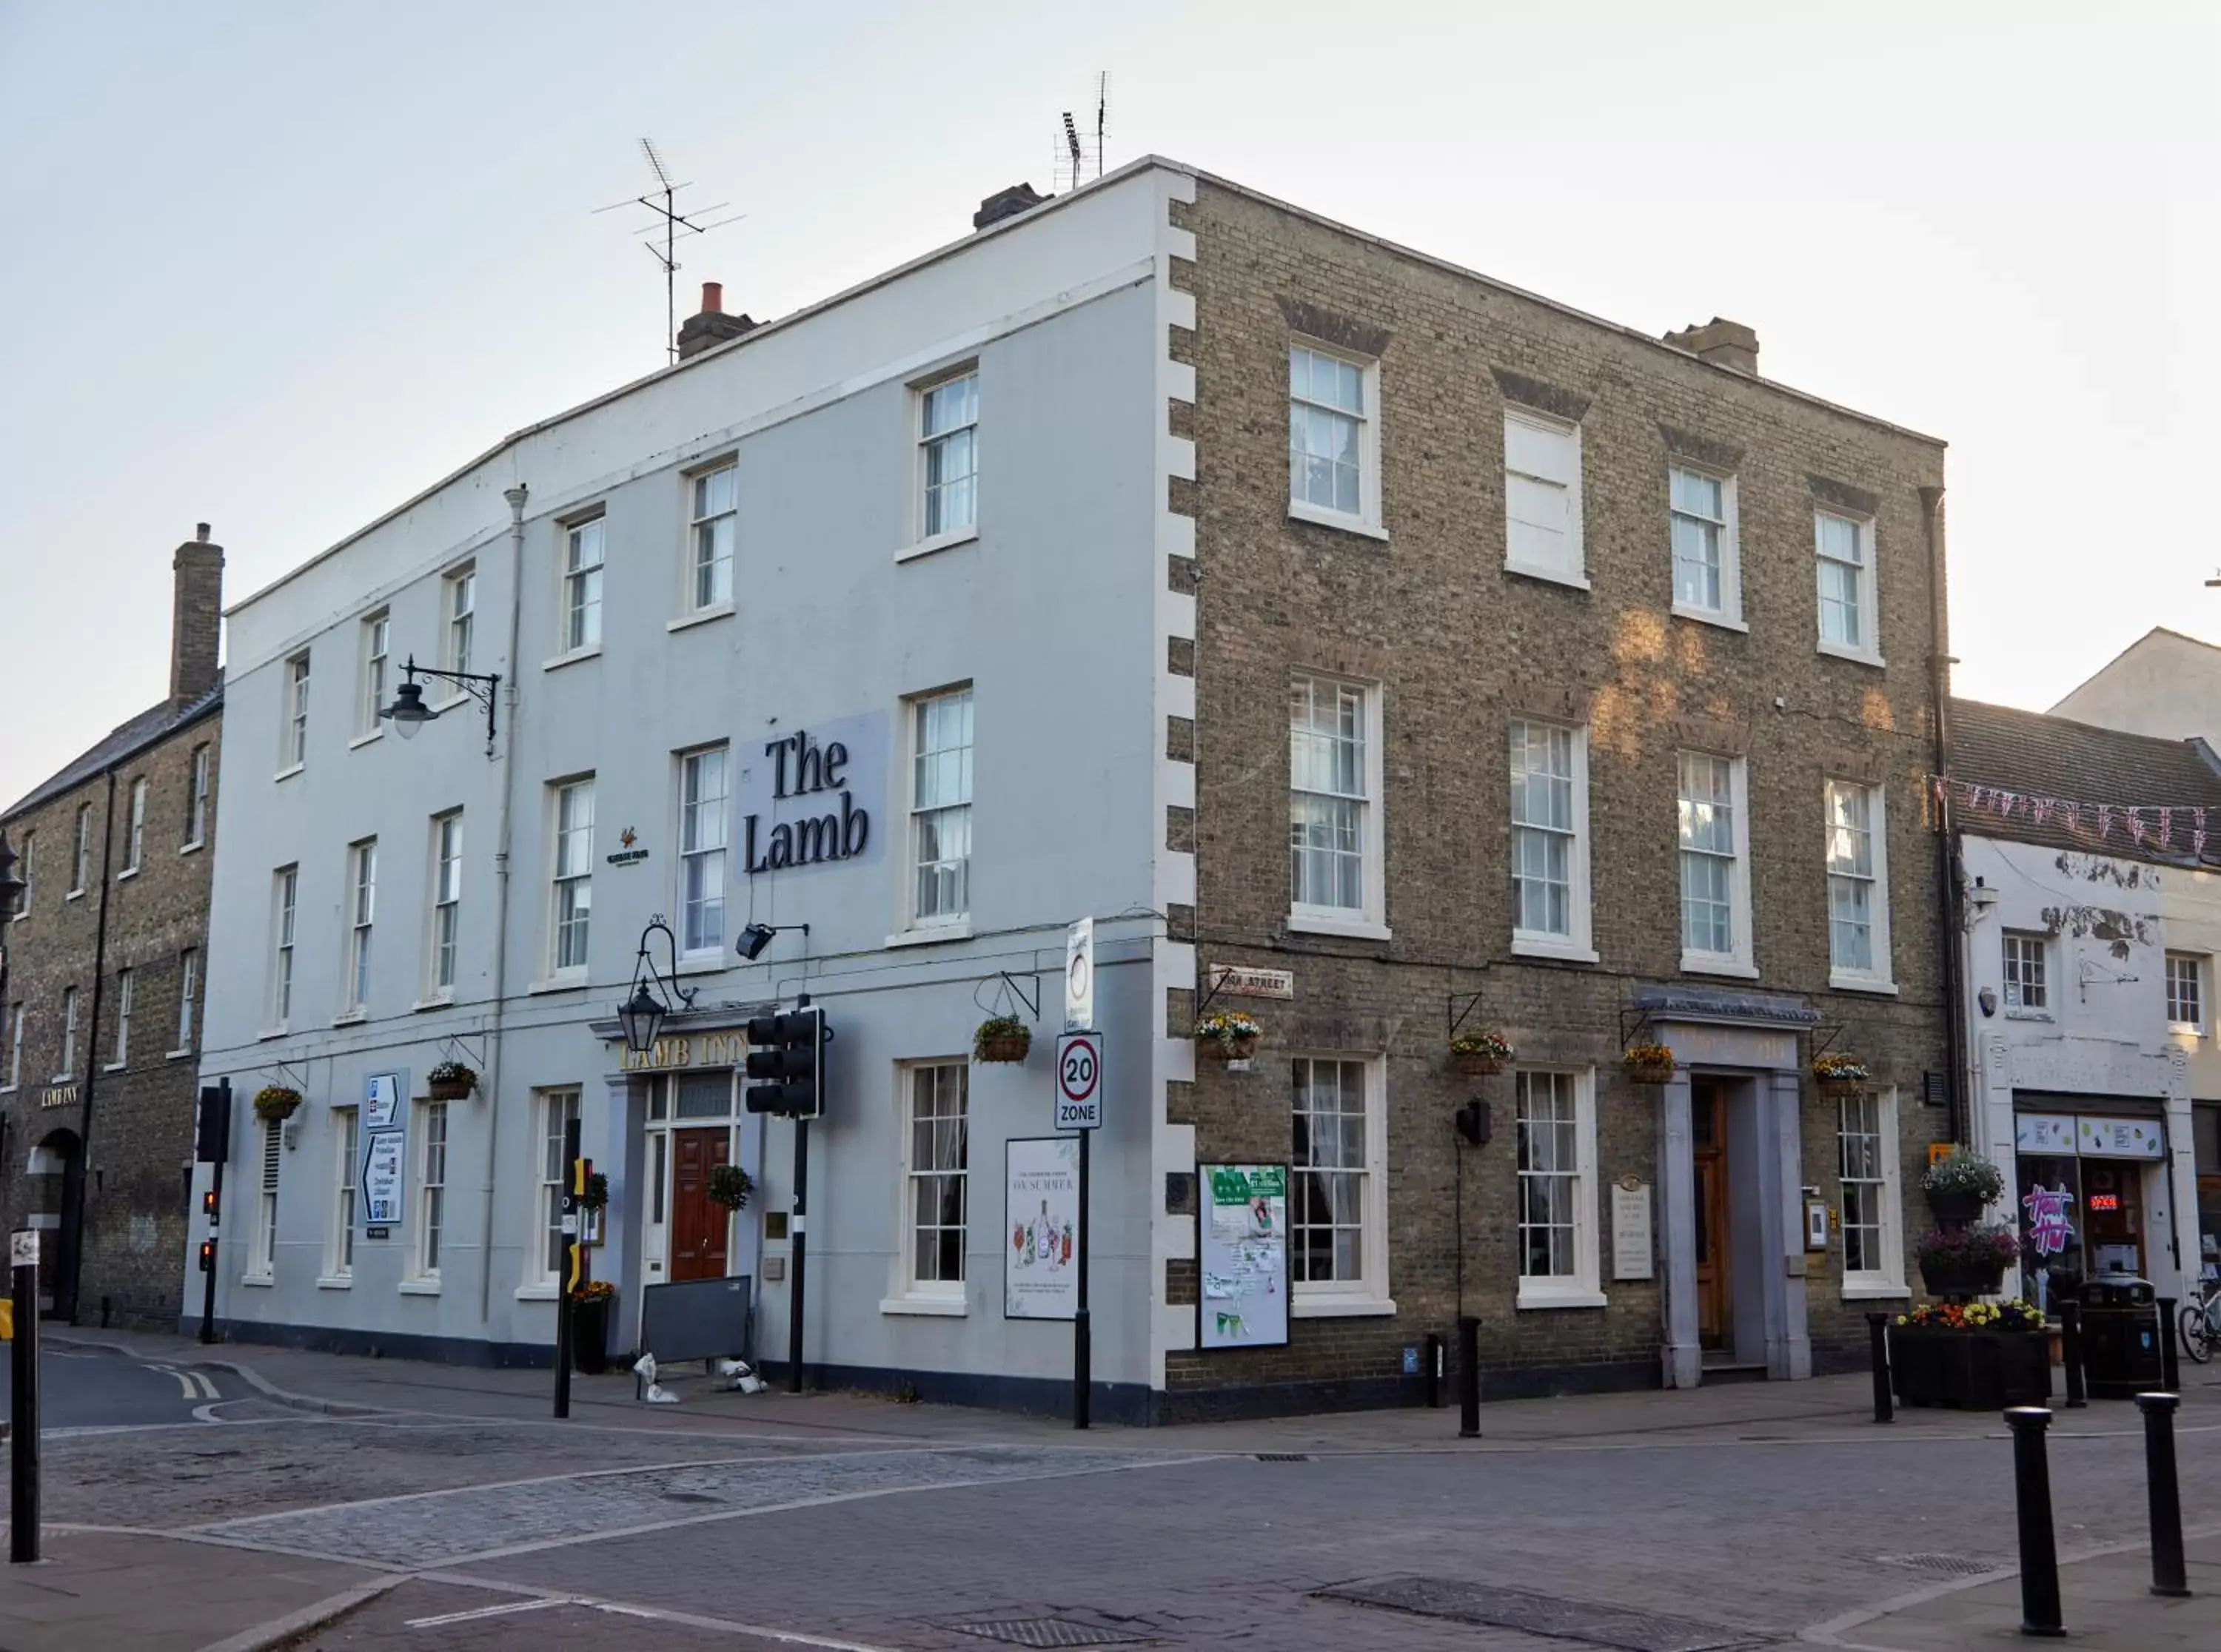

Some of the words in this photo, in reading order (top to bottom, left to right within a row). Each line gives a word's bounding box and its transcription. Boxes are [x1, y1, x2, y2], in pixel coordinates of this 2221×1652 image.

[765, 730, 848, 799] The
[743, 790, 869, 873] Lamb
[620, 1038, 690, 1070] LAMB
[700, 1034, 748, 1066] INN
[1066, 1058, 1092, 1082] 20
[1062, 1105, 1096, 1121] ZONE
